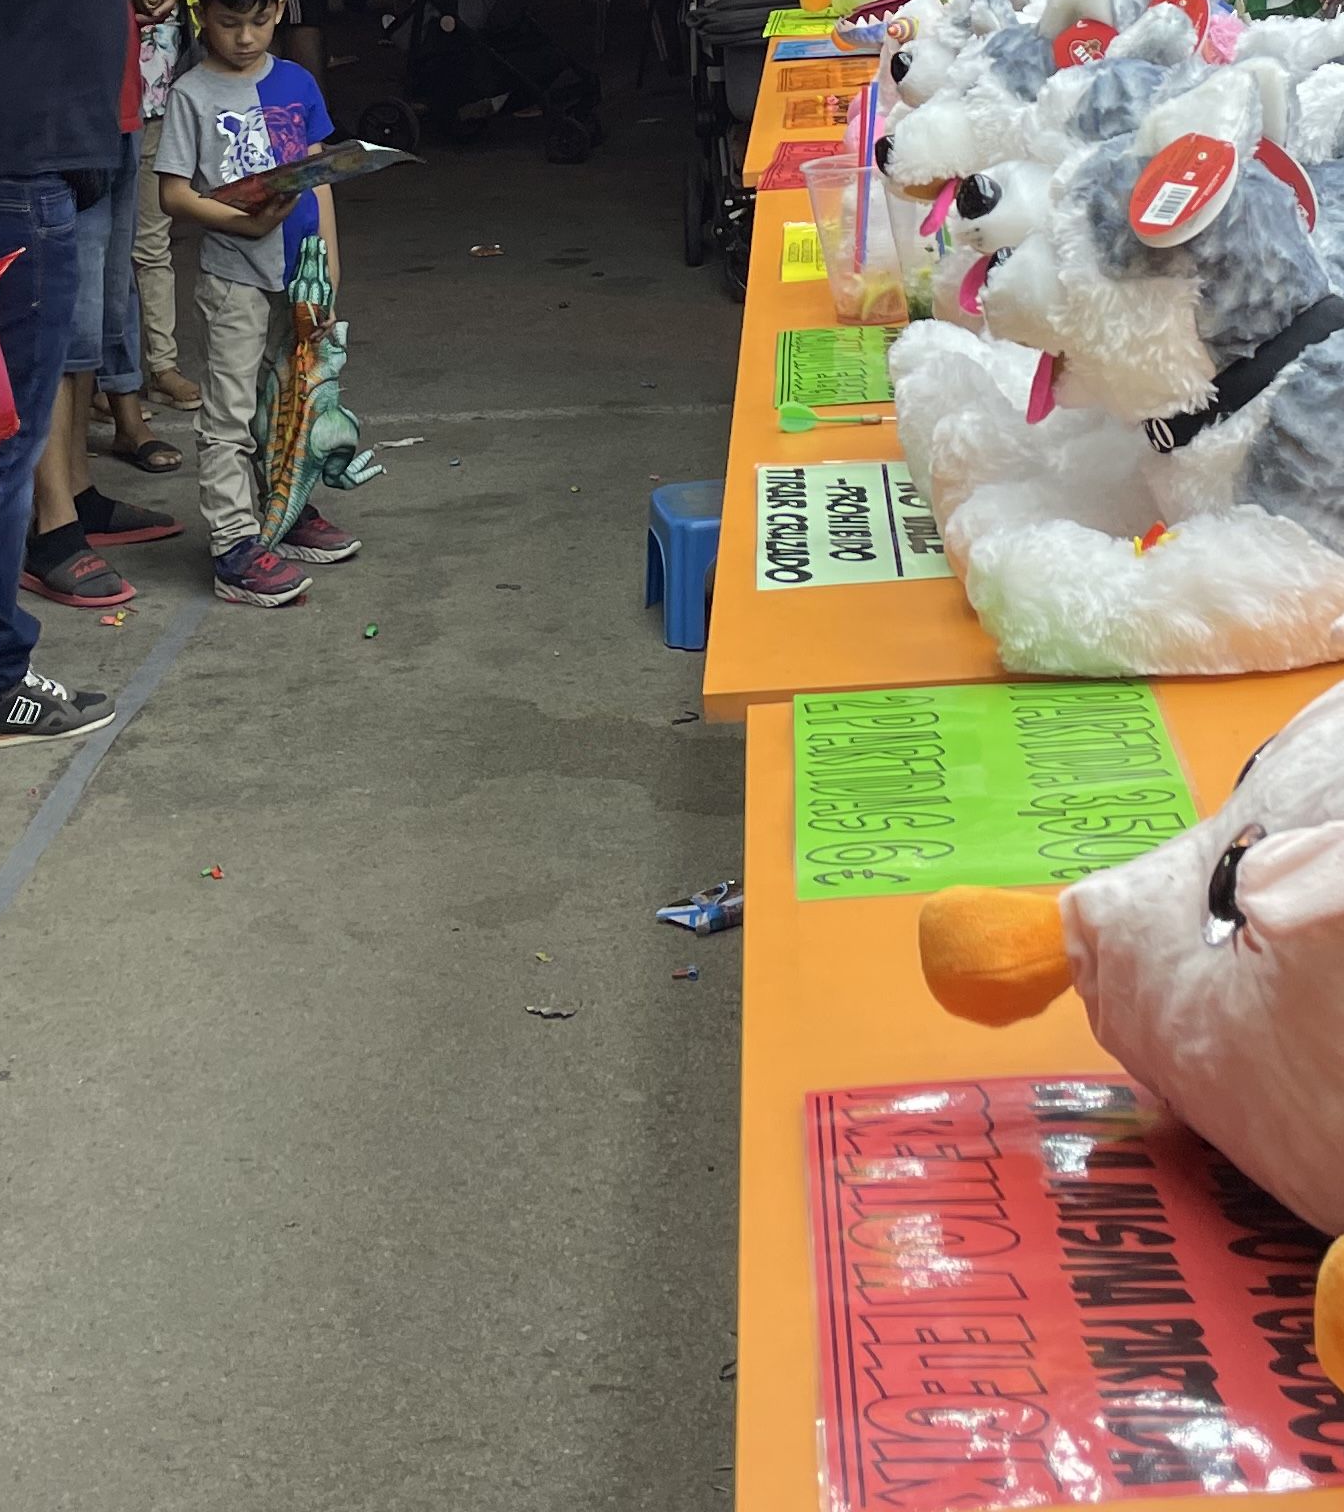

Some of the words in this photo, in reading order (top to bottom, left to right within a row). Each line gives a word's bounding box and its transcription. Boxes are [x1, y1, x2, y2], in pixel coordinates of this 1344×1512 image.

[765, 468, 808, 509] TIRAR
[765, 513, 814, 584] CRUZADO
[902, 514, 945, 555] VALE
[803, 695, 937, 714] 2
[1008, 690, 1173, 789] PARTIDA
[805, 712, 957, 836] PARTIDAS
[1051, 1180, 1194, 1309] MISMA
[1079, 1319, 1246, 1491] PARTIDA
